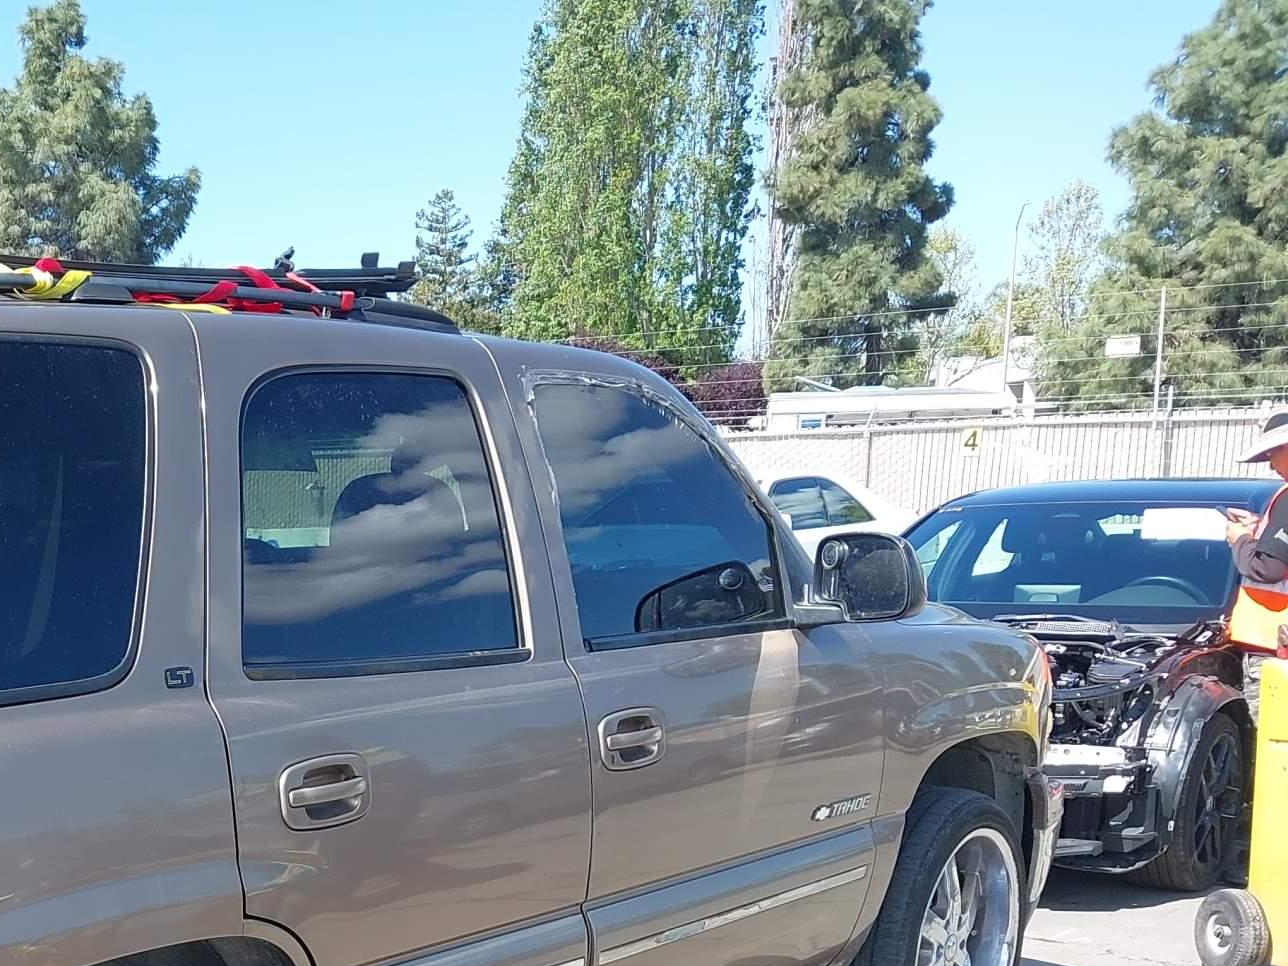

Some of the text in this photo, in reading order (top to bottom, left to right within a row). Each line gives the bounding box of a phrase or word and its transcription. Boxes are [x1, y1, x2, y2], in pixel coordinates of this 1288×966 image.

[964, 430, 978, 451] 4
[166, 669, 191, 685] LT
[831, 795, 872, 817] TAHOE
